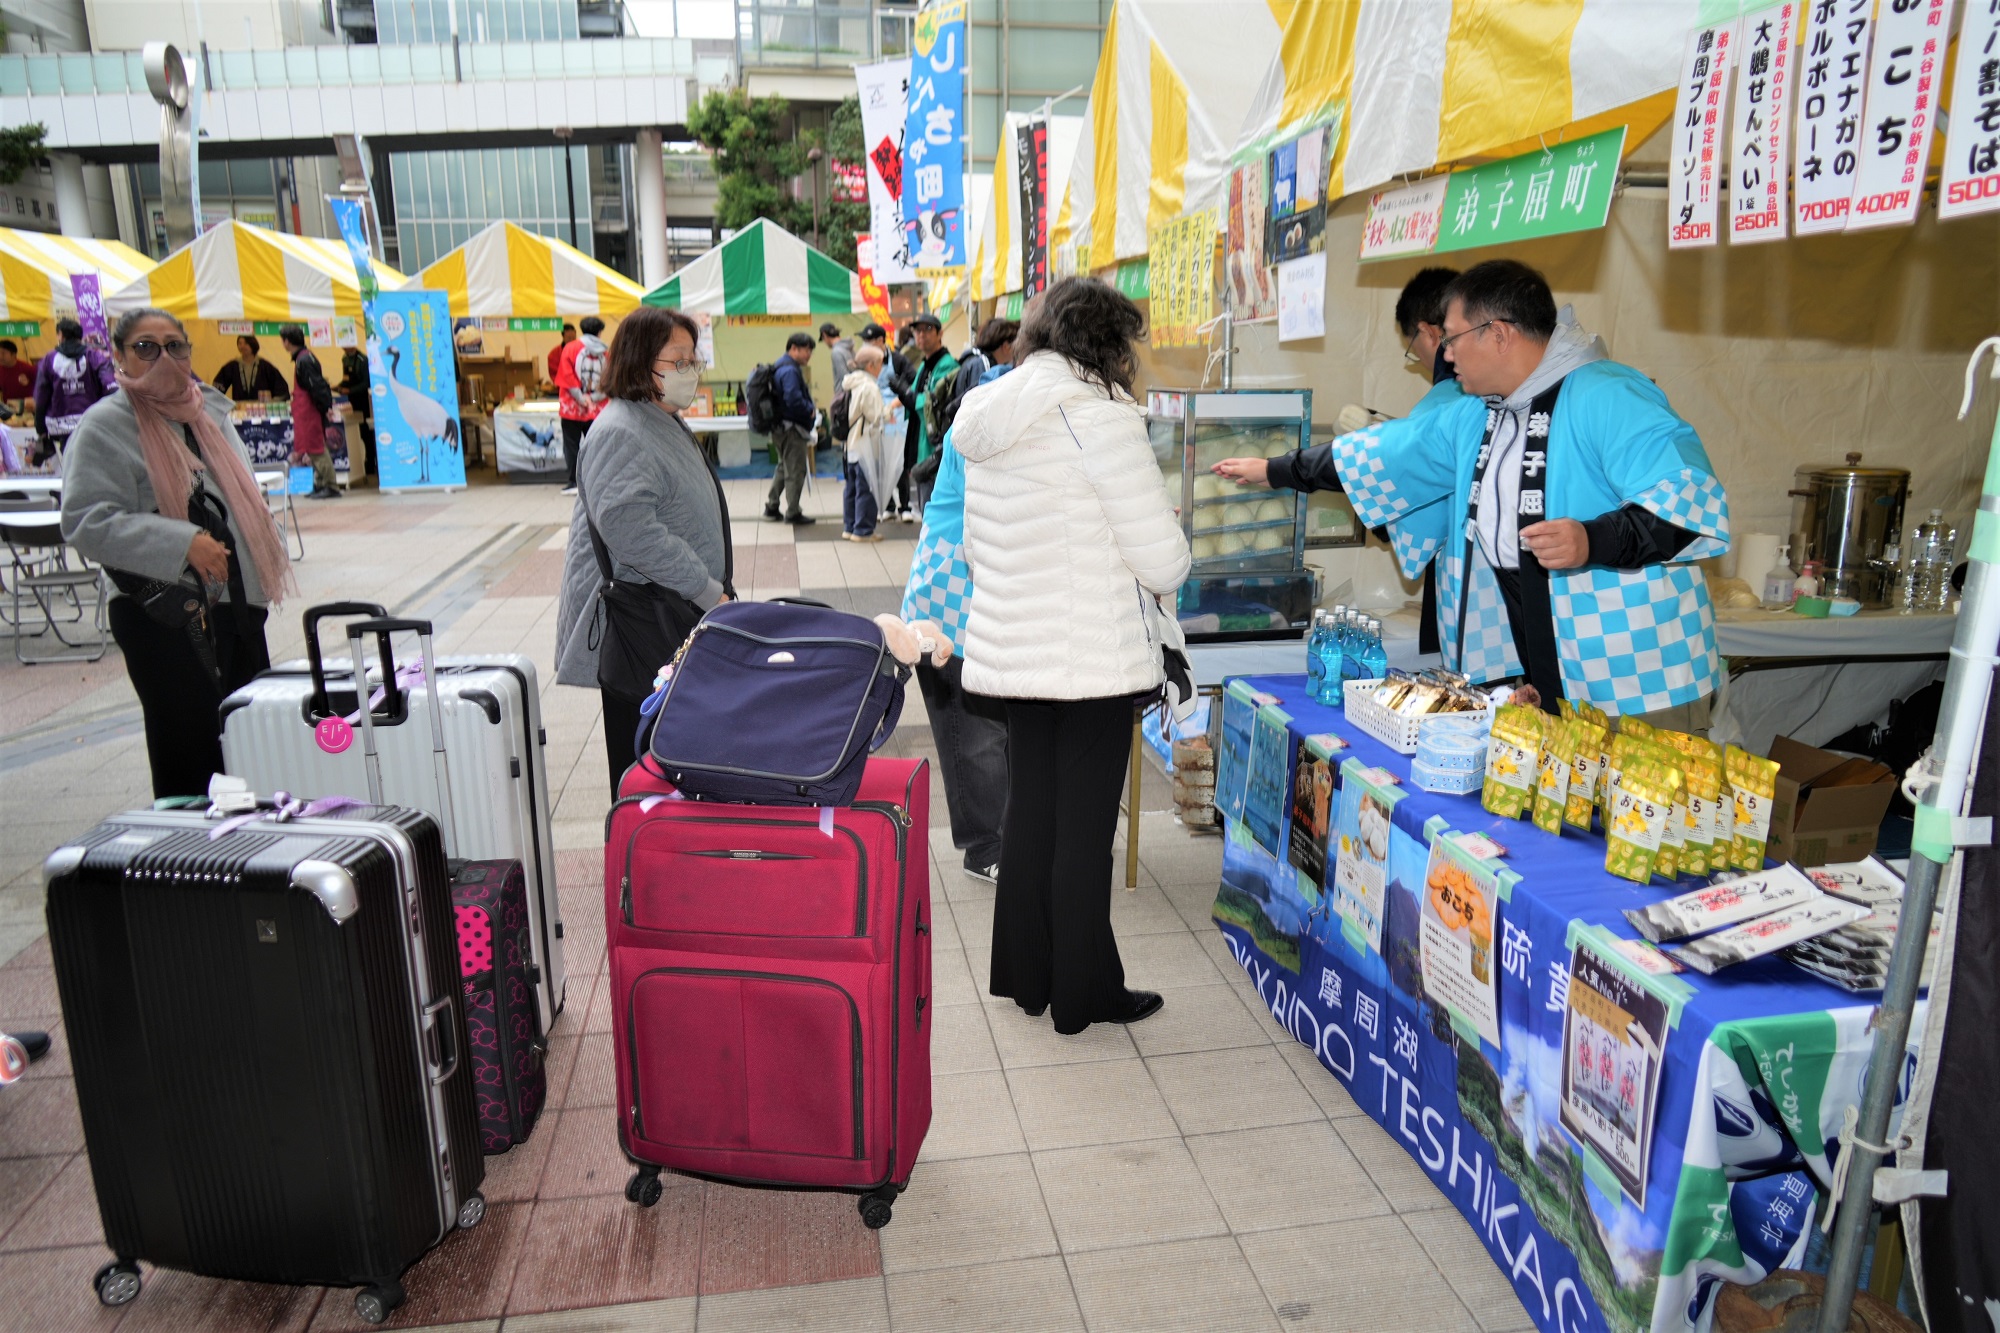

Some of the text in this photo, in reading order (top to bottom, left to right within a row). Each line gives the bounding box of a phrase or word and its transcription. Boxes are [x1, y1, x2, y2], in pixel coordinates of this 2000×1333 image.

[1679, 28, 1715, 225] 摩周ブルーソーダ
[1742, 19, 1773, 190] 大鵬せんべい
[1766, 3, 1791, 210] 弟子屈町のロングセラー商品
[1452, 160, 1598, 236] 弟子屈町
[1800, 197, 1850, 222] 700円
[1855, 190, 1910, 214] 400円
[1367, 211, 1433, 248] 秋の収穫祭
[1673, 222, 1711, 240] 350円
[1734, 213, 1778, 231] 250円
[1620, 794, 1655, 818] おこち
[1441, 884, 1475, 921] おこち
[1318, 966, 1418, 1074] 摩周湖
[1572, 1094, 1624, 1147] 摩周八割そば
[1760, 1173, 1808, 1248] 北海道
